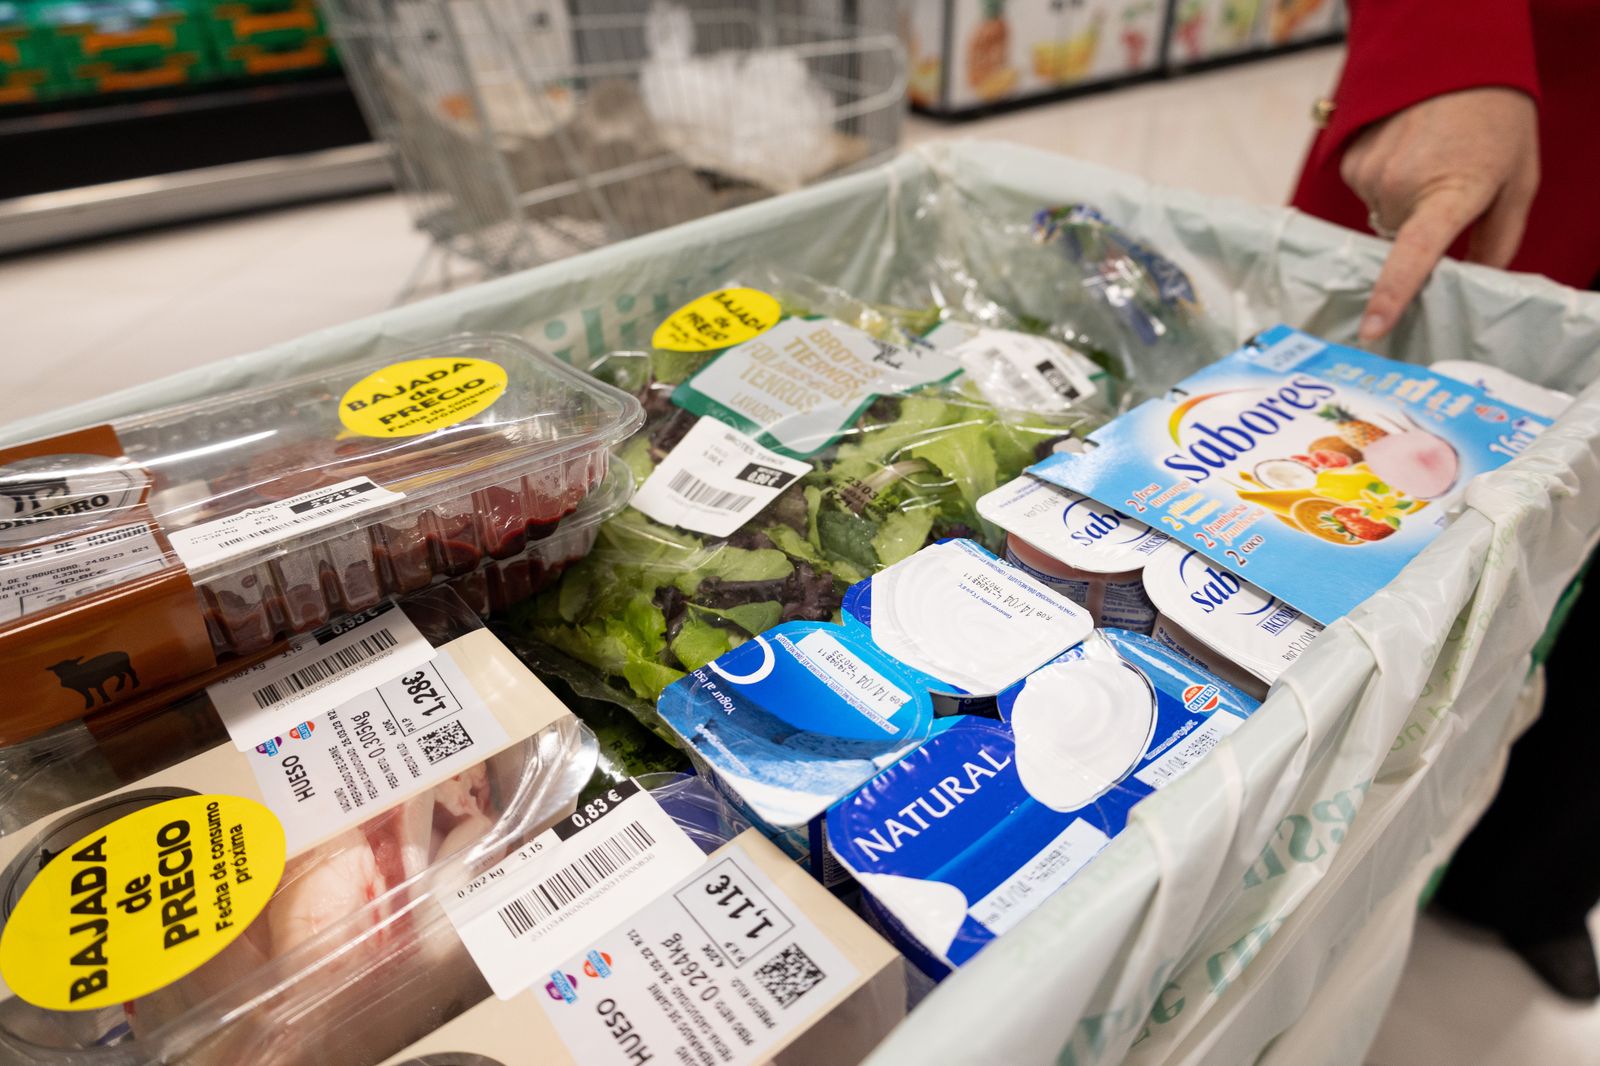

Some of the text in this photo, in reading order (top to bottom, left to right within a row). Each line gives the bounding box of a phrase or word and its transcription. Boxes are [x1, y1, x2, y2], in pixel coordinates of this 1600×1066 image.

[784, 336, 867, 390] TIERNOS
[808, 327, 882, 380] BROTES
[346, 361, 473, 412] BAJADA
[378, 378, 486, 425] PRECIO
[409, 387, 441, 401] de
[387, 413, 428, 432] Fecha
[430, 406, 447, 416] de
[1163, 375, 1336, 485] sabores
[277, 488, 329, 508] CORDERO
[1126, 484, 1161, 512] 2 fresa
[1071, 510, 1131, 546] sab
[1161, 516, 1183, 530] 2
[1195, 533, 1216, 548] 2
[1225, 535, 1264, 566] 2 coco
[1004, 593, 1033, 616] 14/04
[1190, 566, 1247, 614] sab
[252, 661, 266, 673] kg
[833, 649, 857, 671] TA0733
[401, 670, 447, 718] 1,28€
[701, 679, 715, 694] al
[857, 673, 888, 701] 14/04
[1188, 685, 1220, 713] GLUTEN
[711, 689, 736, 716] Yogur
[332, 720, 351, 746] 25.03.23
[350, 710, 386, 759] 0,305kg
[382, 718, 397, 736] 4,20€
[402, 716, 415, 732] P.V.P
[281, 754, 316, 803] HUESO
[328, 745, 365, 804] PREPARADO DE CARNE
[385, 772, 399, 788] PESO
[404, 756, 421, 777] PRECIO
[334, 787, 352, 812] VACUNO
[364, 779, 379, 798] FECHA
[571, 788, 621, 828] 0,83 €
[853, 746, 1013, 863] NATURAL
[205, 801, 235, 932] Fecha de consumo
[229, 823, 253, 885] próxima
[156, 819, 200, 950] PRECIO
[488, 865, 504, 880] kg
[116, 873, 153, 915] de
[705, 874, 775, 940] 1,11€
[69, 835, 110, 1004] BAJADA
[660, 932, 720, 1001] 0,264kg
[596, 997, 656, 1066] HUESO
